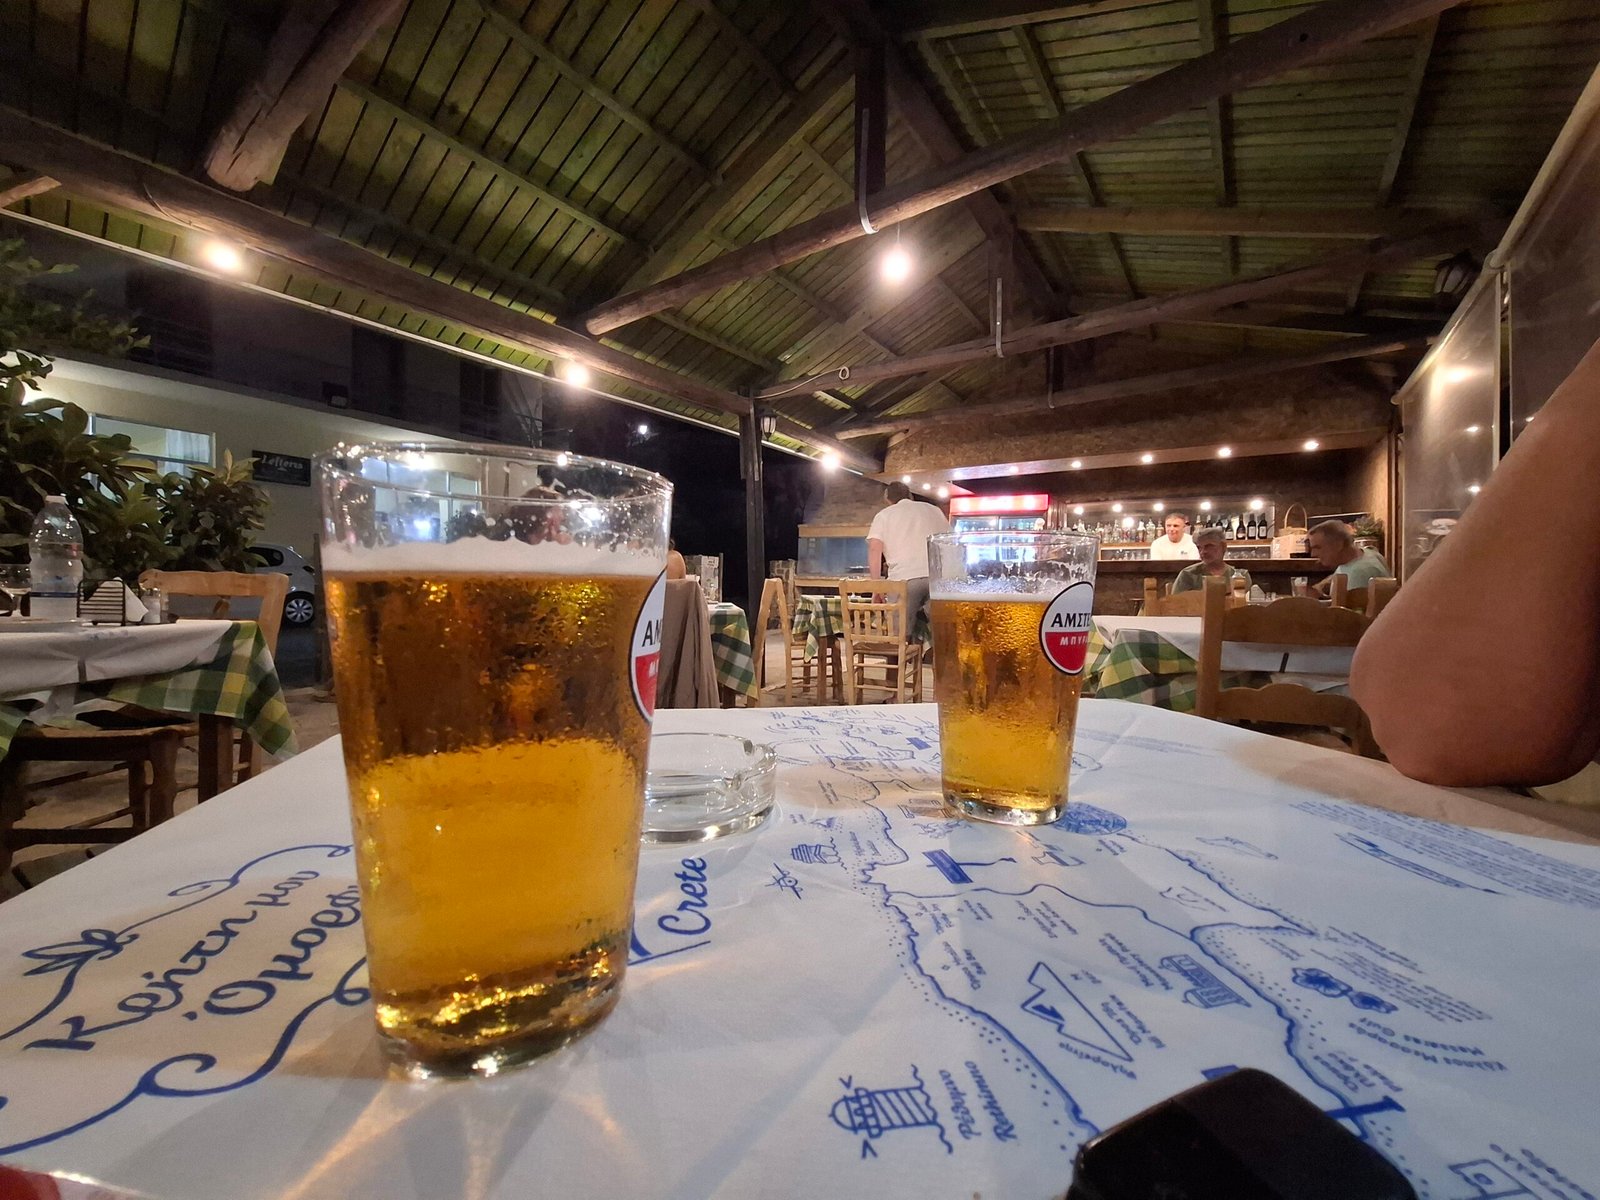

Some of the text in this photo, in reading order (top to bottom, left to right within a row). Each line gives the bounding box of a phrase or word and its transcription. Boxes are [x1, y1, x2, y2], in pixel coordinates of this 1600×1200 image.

[246, 869, 320, 909] μου
[658, 857, 712, 937] Crete
[185, 884, 362, 1022] Όμορφ
[964, 1060, 1018, 1143] Rethimno
